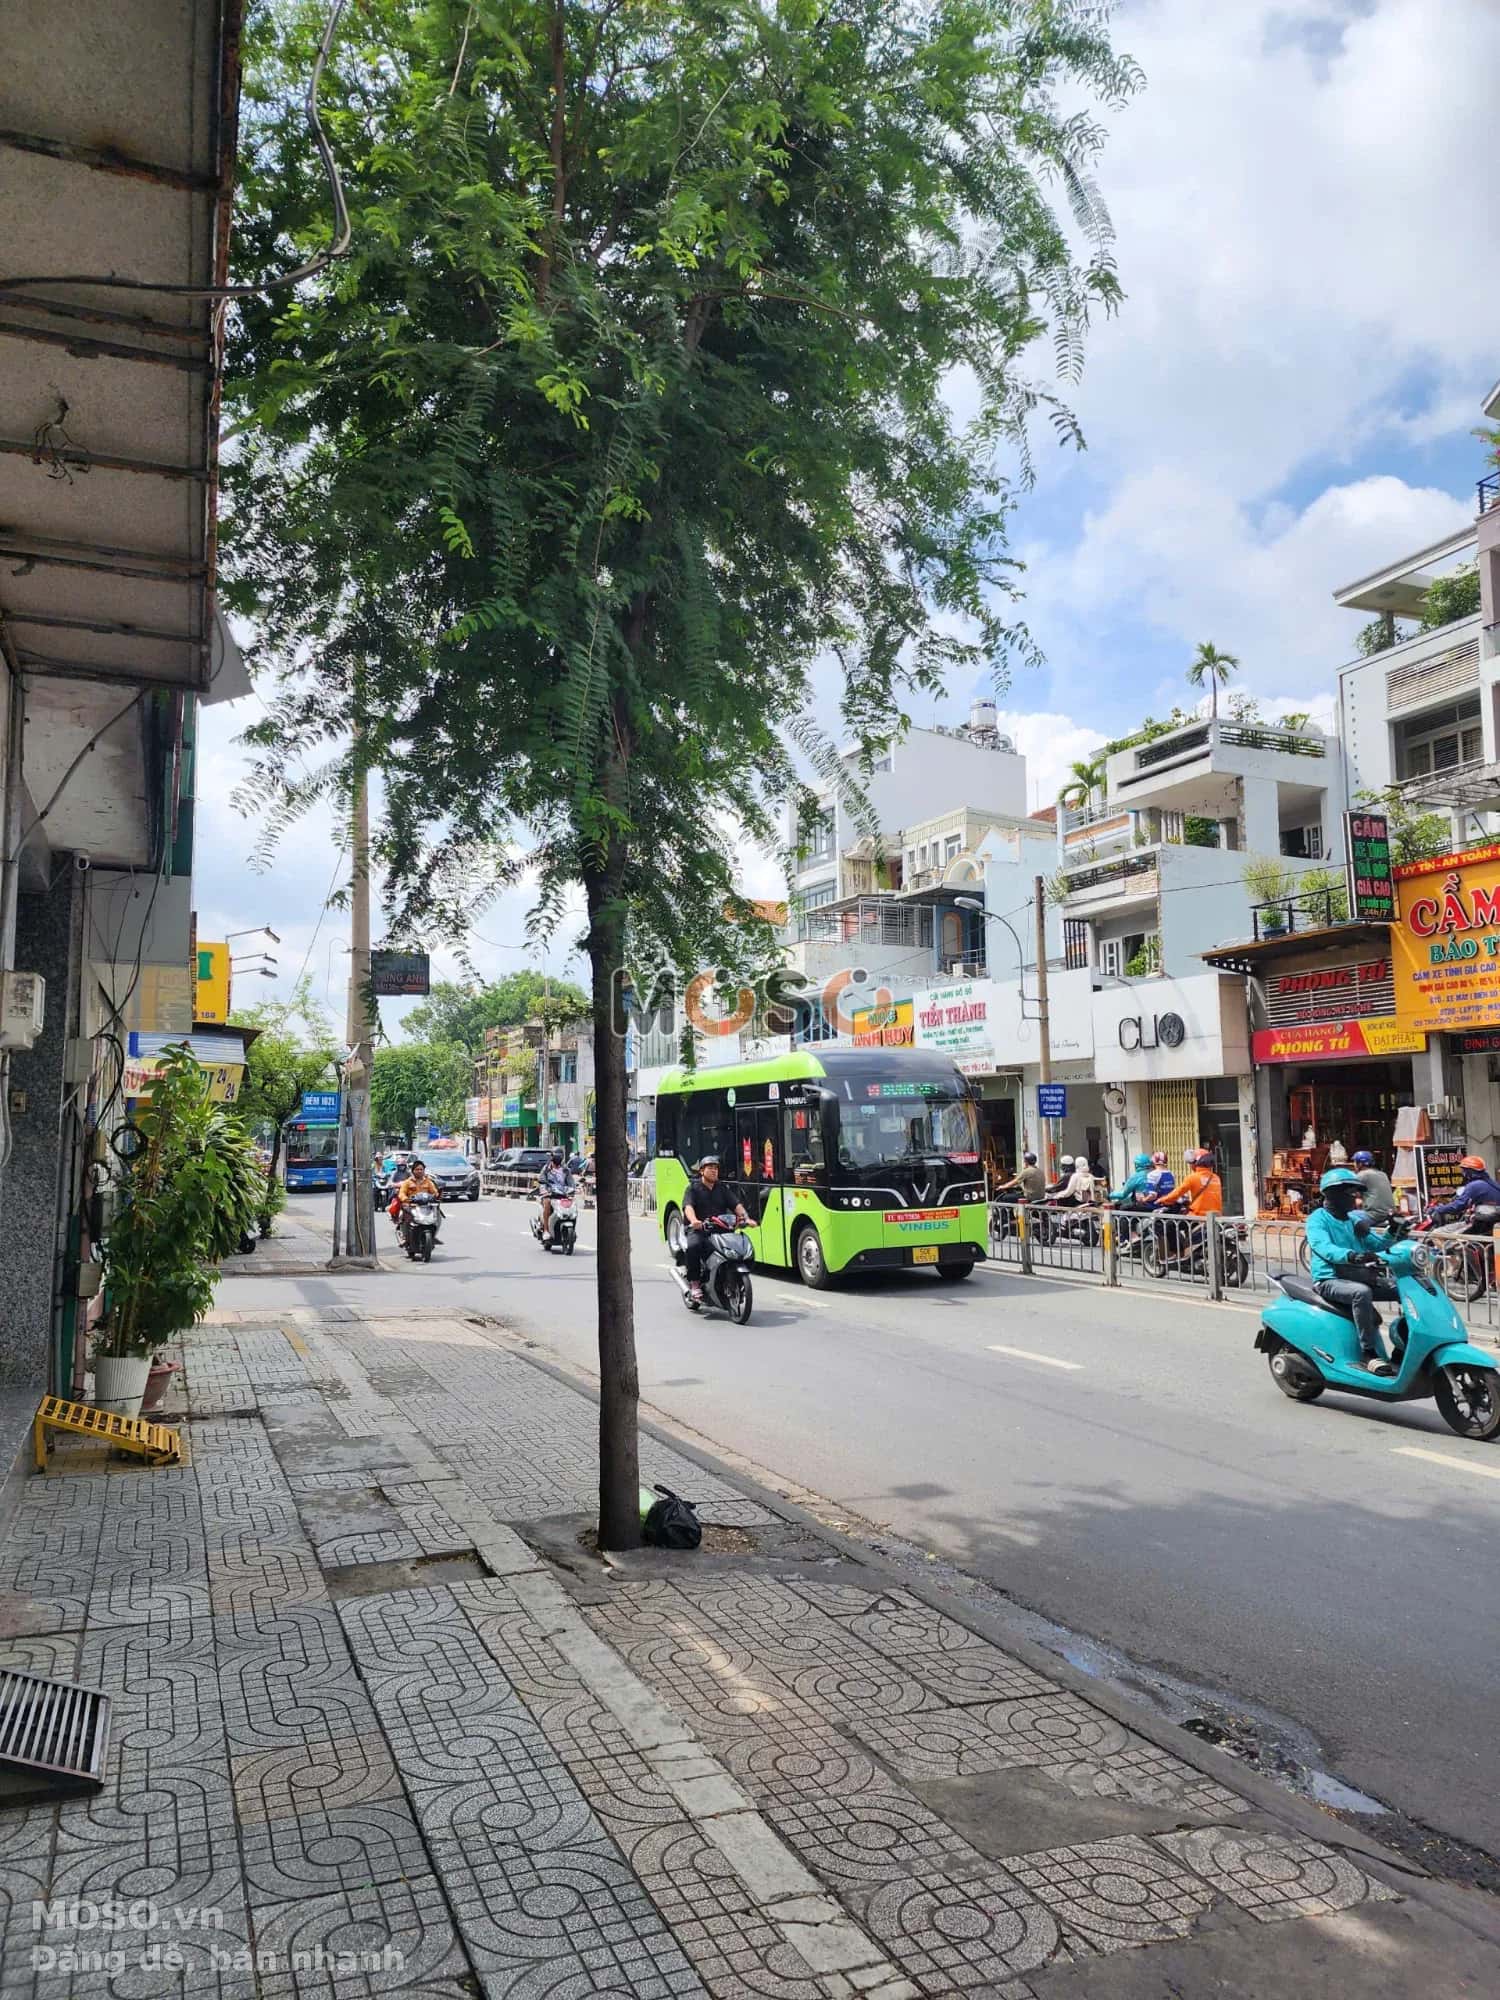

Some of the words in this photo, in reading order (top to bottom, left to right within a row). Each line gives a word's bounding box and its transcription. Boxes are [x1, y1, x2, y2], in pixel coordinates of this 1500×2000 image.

[1402, 866, 1416, 875] UY
[1442, 857, 1458, 867] AN
[1357, 878, 1372, 896] GIÁ
[1374, 881, 1391, 897] CAO
[945, 1000, 987, 1025] THÀNH
[853, 1031, 882, 1047] ANH
[899, 1221, 949, 1231] VINBUS
